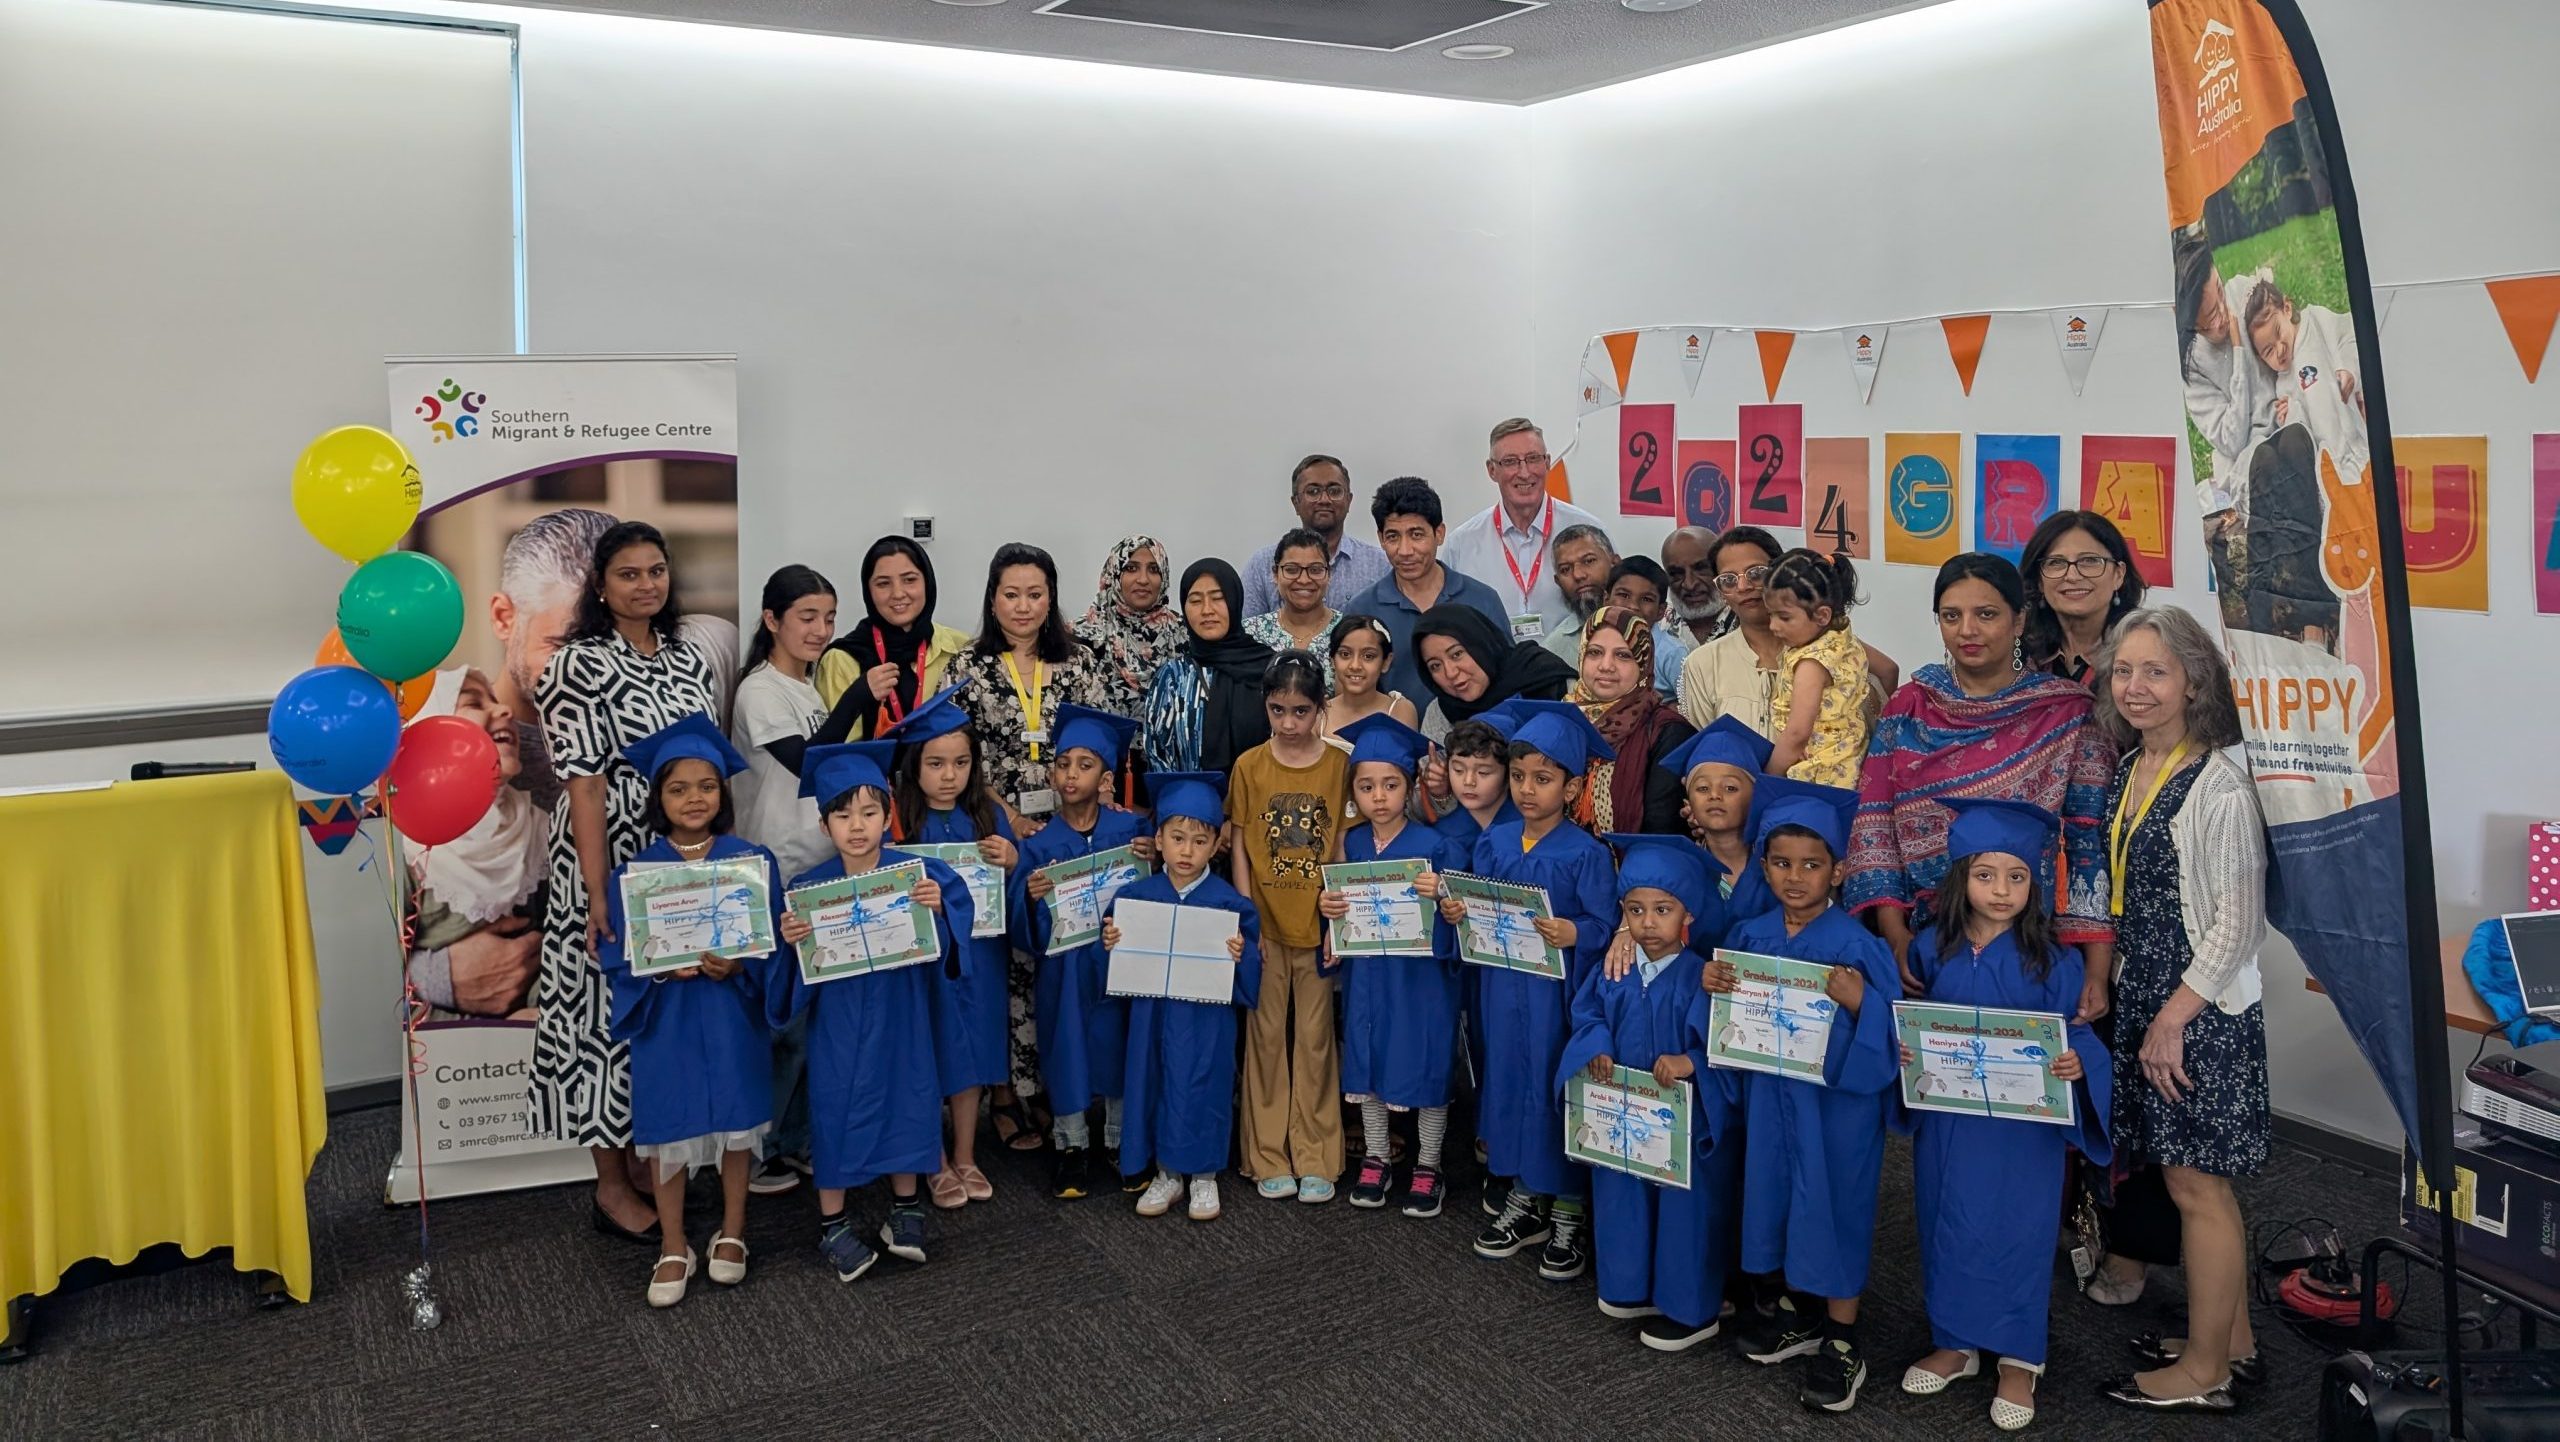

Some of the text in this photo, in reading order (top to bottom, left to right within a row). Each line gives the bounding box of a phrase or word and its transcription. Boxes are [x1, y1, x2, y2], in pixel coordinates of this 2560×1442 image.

[2197, 68, 2239, 117] HIPPY
[2197, 98, 2242, 137] Australia
[491, 409, 569, 423] Southern
[492, 423, 712, 443] Migrant & Refugee Centre
[2231, 678, 2357, 735] HIPPY
[2245, 739, 2350, 758] milies learning together
[2269, 757, 2288, 770] and
[2292, 758, 2314, 771] free
[2315, 761, 2353, 775] activities
[1386, 873, 1406, 882] 2024
[656, 880, 707, 893] raduation
[818, 883, 895, 907] Graduaton 2024
[830, 925, 857, 937] HIPPY
[1743, 969, 1819, 990] Graduaton 2024
[1746, 1007, 1772, 1018] HIPPY
[1930, 1021, 2024, 1037] Graduaton 2024
[1941, 1056, 1973, 1066] HIPPY
[435, 1059, 527, 1083] Contact
[1638, 1085, 1660, 1098] 2024
[459, 1117, 474, 1128] 03
[477, 1113, 507, 1126] 9767
